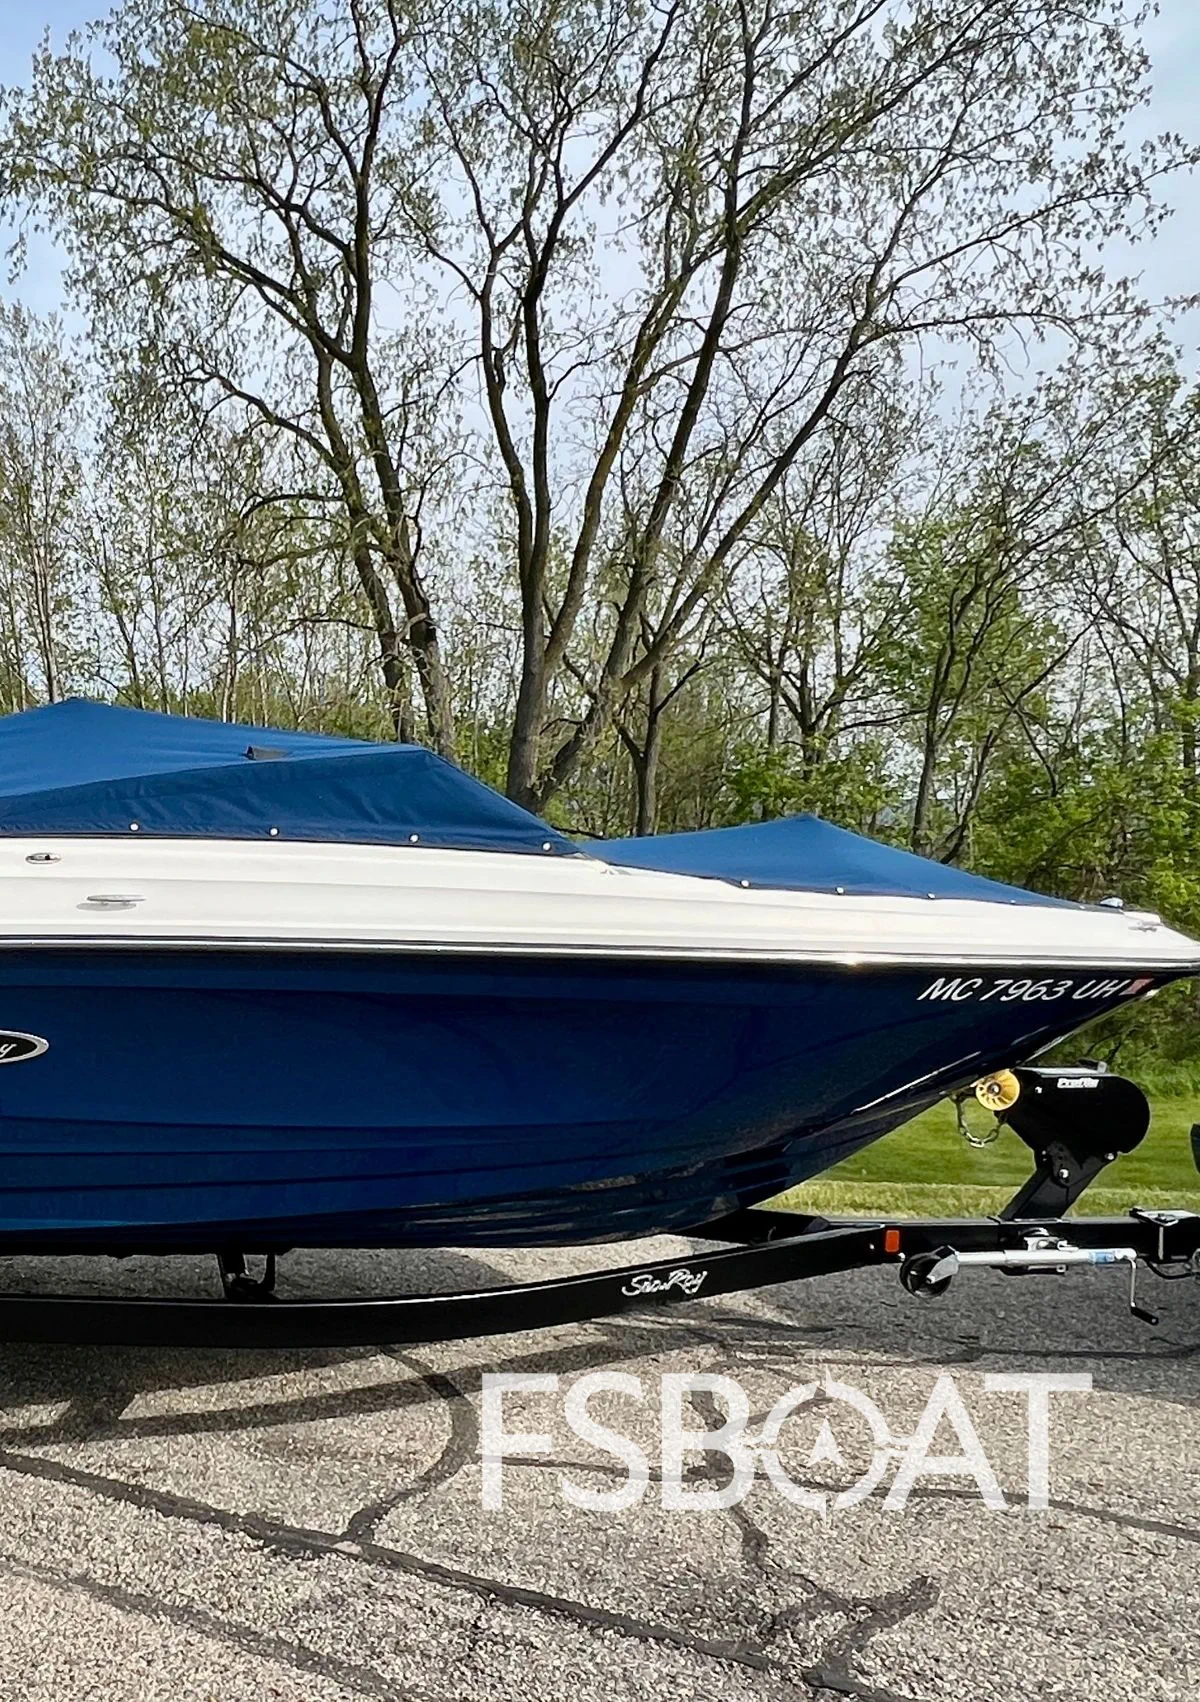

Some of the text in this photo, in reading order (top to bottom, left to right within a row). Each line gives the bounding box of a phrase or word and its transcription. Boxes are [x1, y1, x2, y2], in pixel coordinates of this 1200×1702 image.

[916, 977, 1131, 1002] MC 7963 UH
[621, 1268, 708, 1297] Sea Ray
